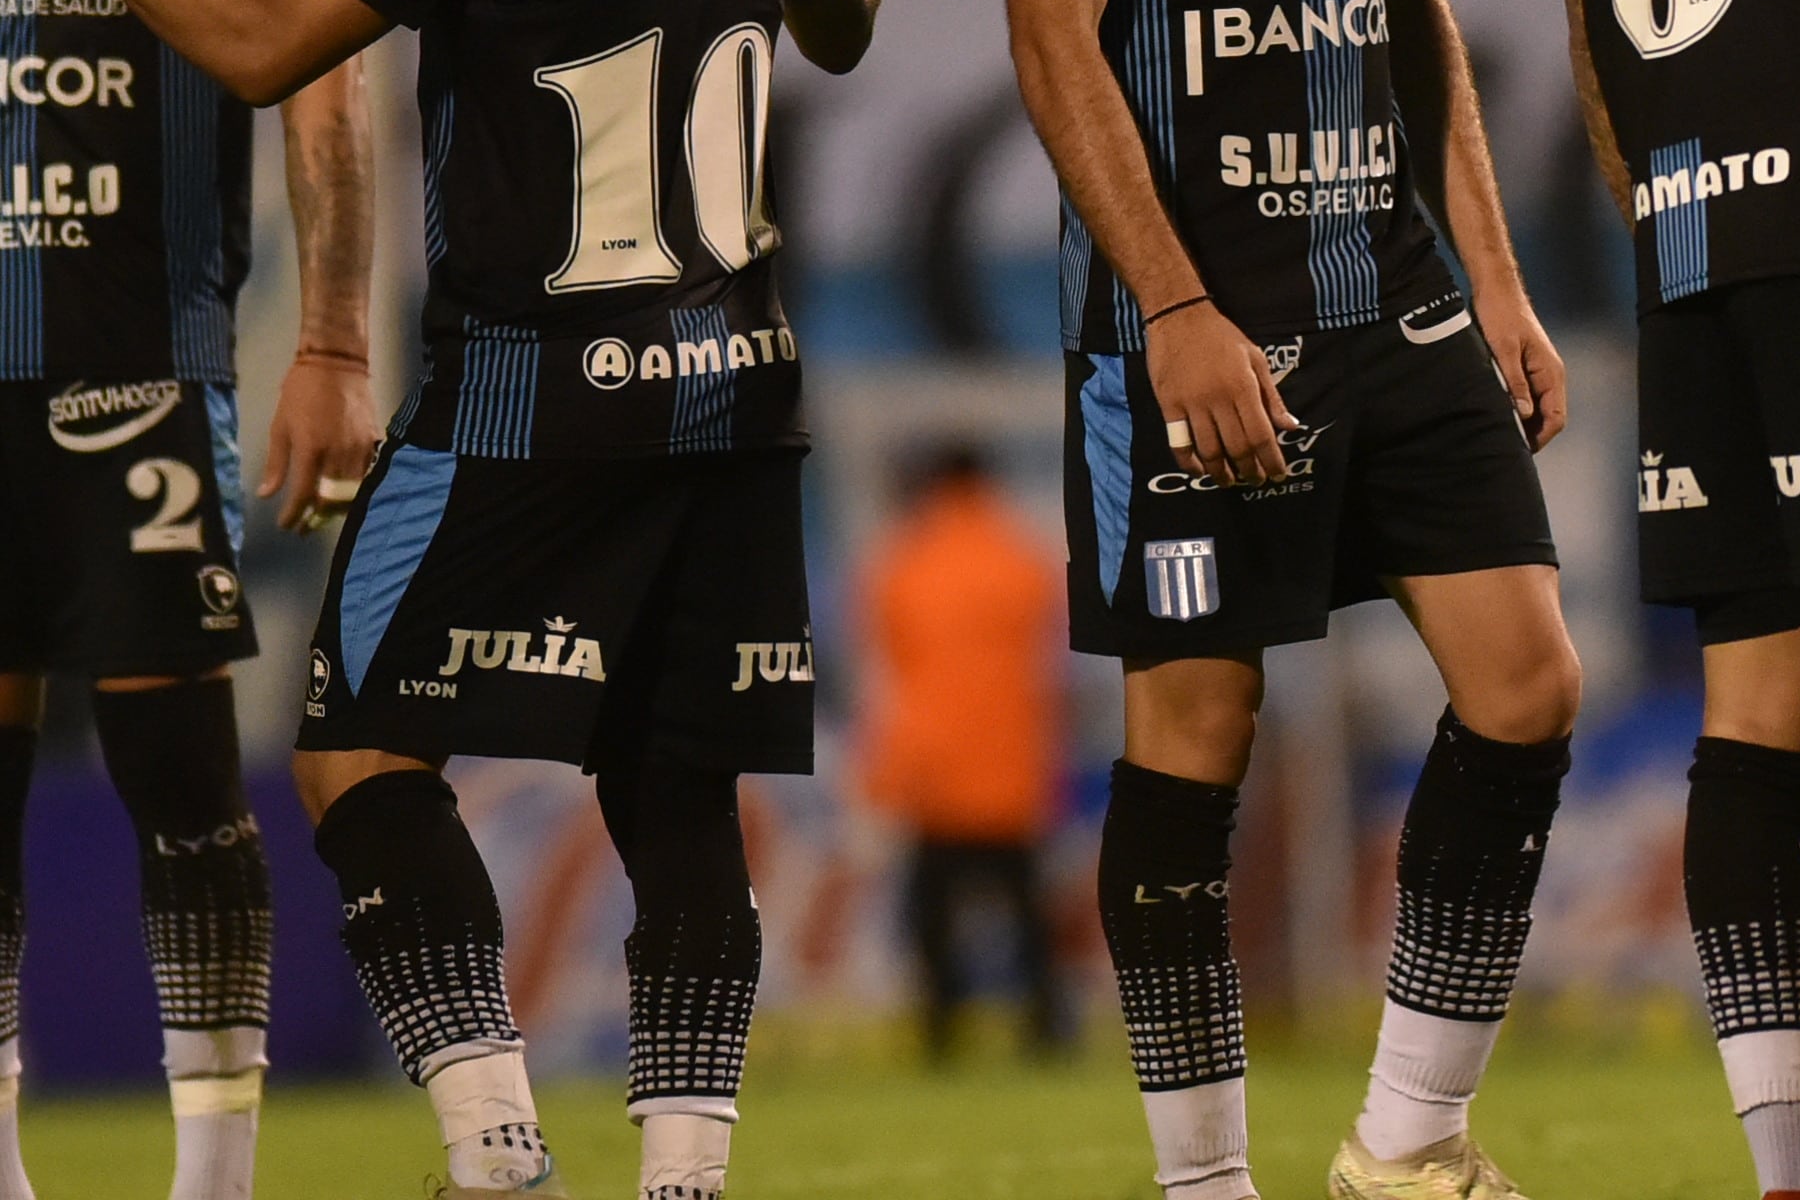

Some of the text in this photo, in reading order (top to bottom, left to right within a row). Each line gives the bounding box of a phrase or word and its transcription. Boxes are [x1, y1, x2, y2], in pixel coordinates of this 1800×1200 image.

[534, 21, 782, 294] 10
[1633, 147, 1791, 222] AMATO
[602, 238, 637, 250] LYON
[640, 328, 798, 380] AMATO
[125, 457, 204, 553] 2
[1241, 480, 1315, 502] VIAJES
[399, 678, 458, 699] LYON
[155, 811, 259, 855] LYON
[1133, 879, 1231, 904] LYO
